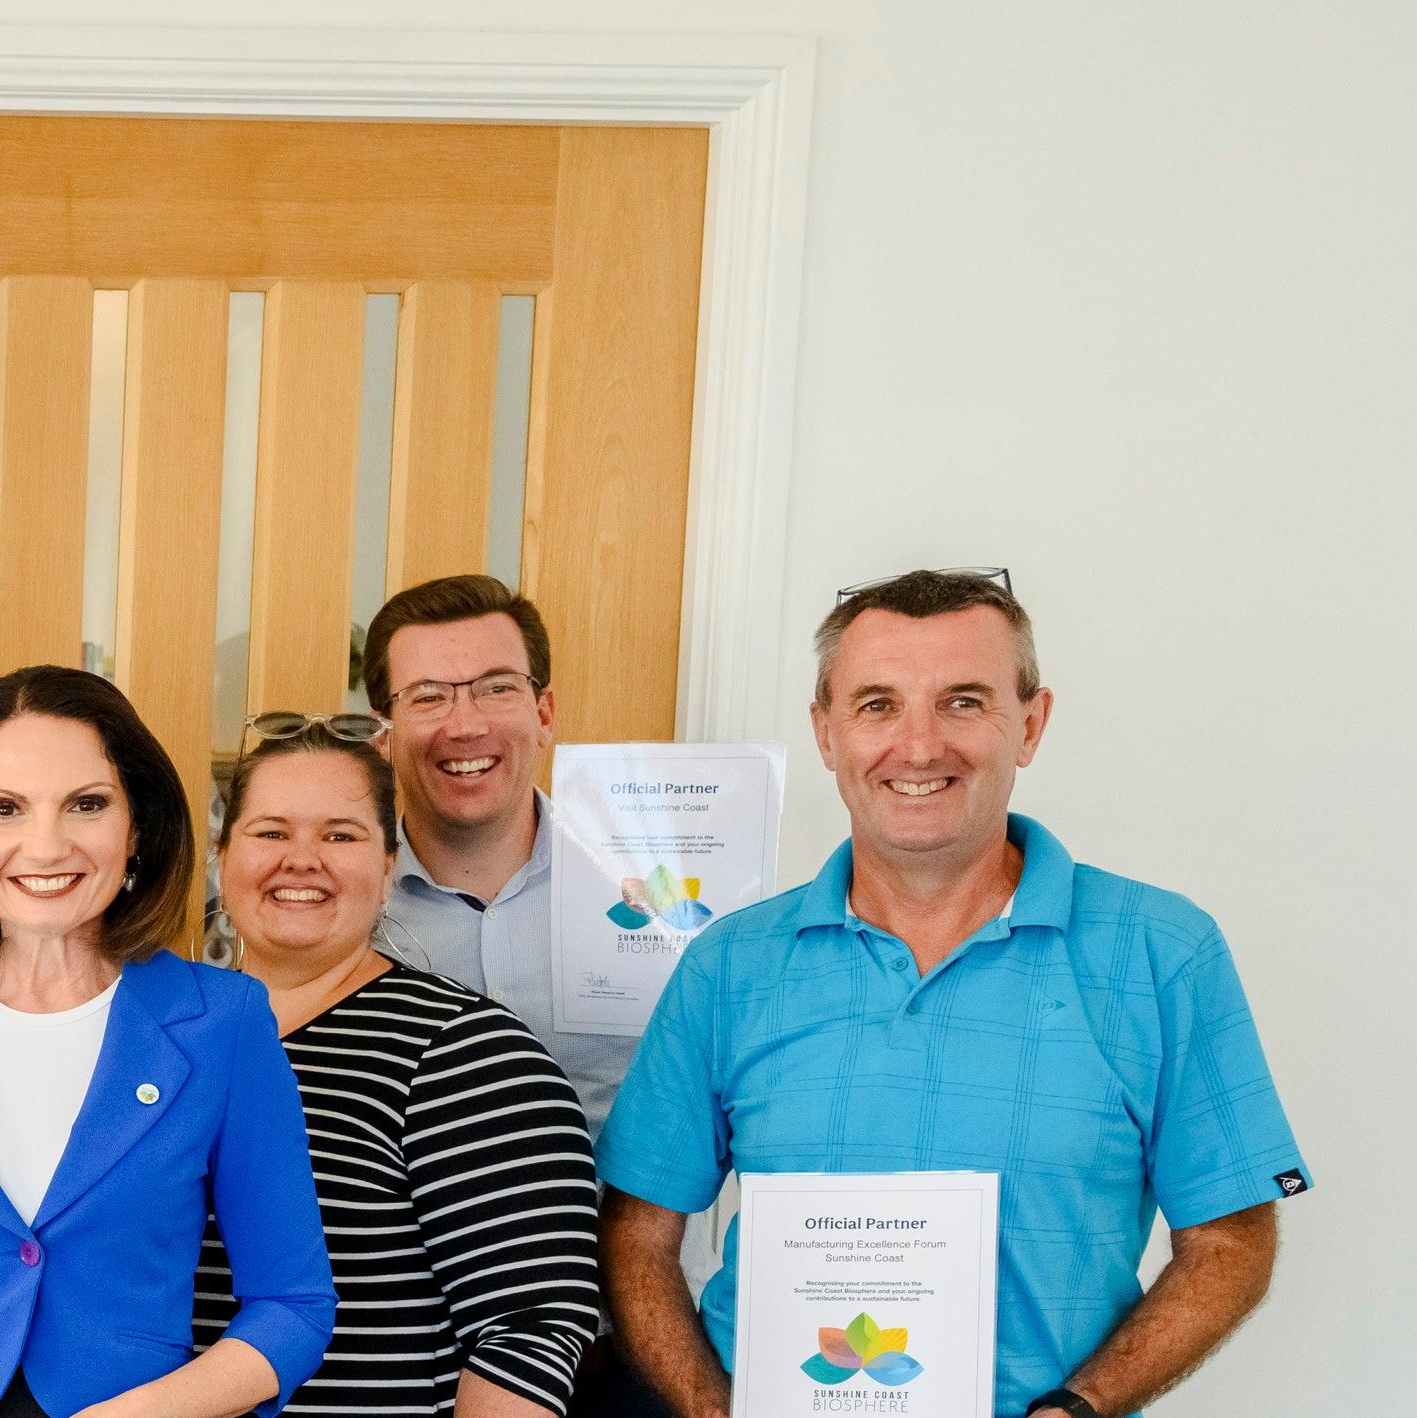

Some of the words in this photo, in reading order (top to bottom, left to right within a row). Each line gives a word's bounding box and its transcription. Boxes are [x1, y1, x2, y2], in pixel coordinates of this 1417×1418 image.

[611, 783, 660, 794] Official
[665, 783, 719, 794] Partner
[618, 804, 637, 812] Visit
[805, 1218, 861, 1229] Official
[866, 1218, 927, 1229] Partner
[784, 1240, 853, 1250] Manufacturing
[857, 1240, 910, 1248] Excellence
[914, 1240, 946, 1248] Forum
[825, 1254, 871, 1262] Sunshine
[874, 1254, 904, 1262] Coast
[814, 1390, 867, 1398] SUNSHINE
[813, 1399, 908, 1413] BIOSPHERE
